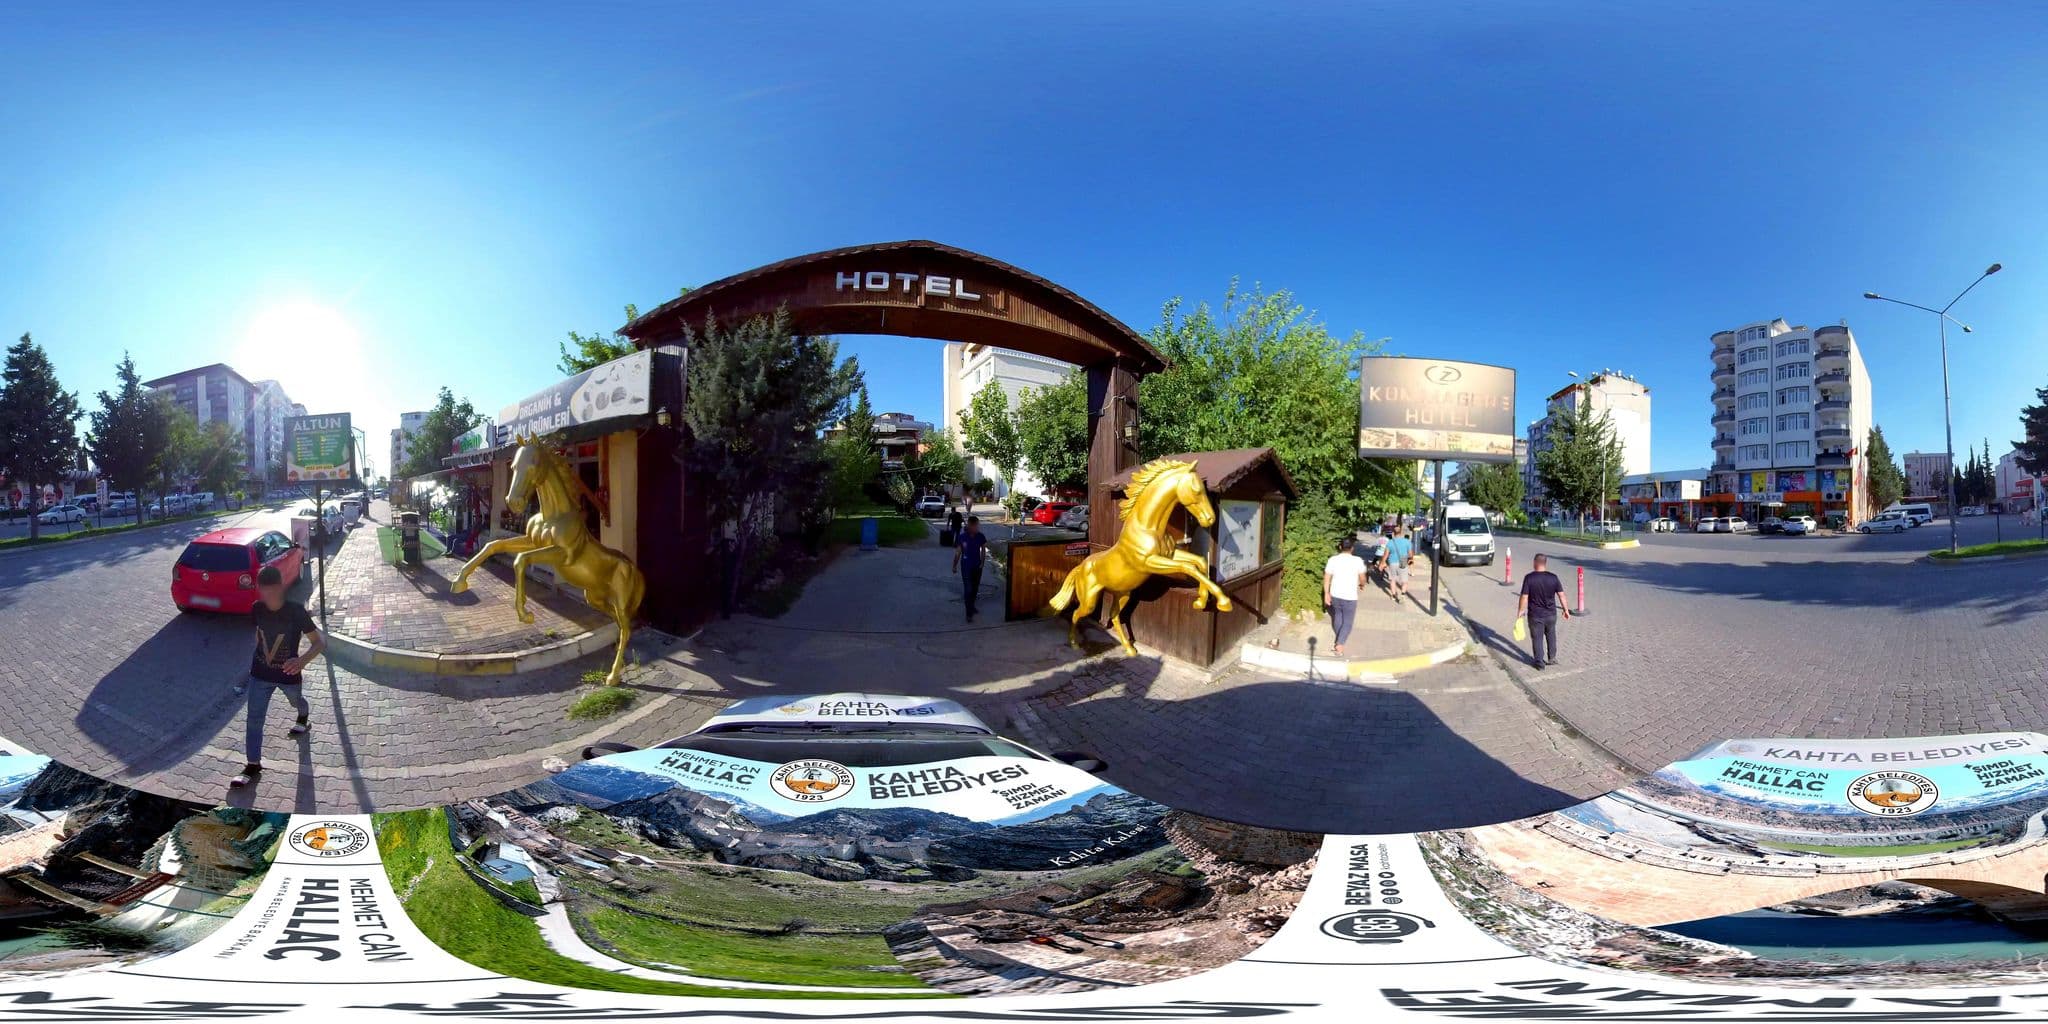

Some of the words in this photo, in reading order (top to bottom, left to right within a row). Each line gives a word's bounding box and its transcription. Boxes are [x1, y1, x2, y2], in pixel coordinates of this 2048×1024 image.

[836, 271, 981, 301] HOTEL
[293, 417, 342, 431] ALTUN
[1405, 408, 1477, 428] HOTEL
[820, 701, 888, 709] KAHTA
[671, 750, 726, 768] MEHMET
[730, 763, 760, 774] CAN
[1764, 748, 1863, 763] KAHTA
[775, 763, 801, 782] KAHTA
[868, 766, 964, 786] KAHTA
[1731, 760, 1792, 776] MEHMET
[1795, 770, 1829, 780] CAN
[1981, 769, 2045, 788] ZAMANI
[1852, 776, 1877, 796] KAHTA
[1012, 789, 1067, 810] ZAMANI
[1048, 846, 1105, 867] Kahta
[1102, 823, 1148, 846] Kalesi
[1349, 844, 1369, 870] MASA
[1345, 873, 1371, 905] BEYAZ
[350, 878, 388, 929] MEHMET
[1353, 917, 1401, 935] 185
[359, 933, 414, 961] CAN
